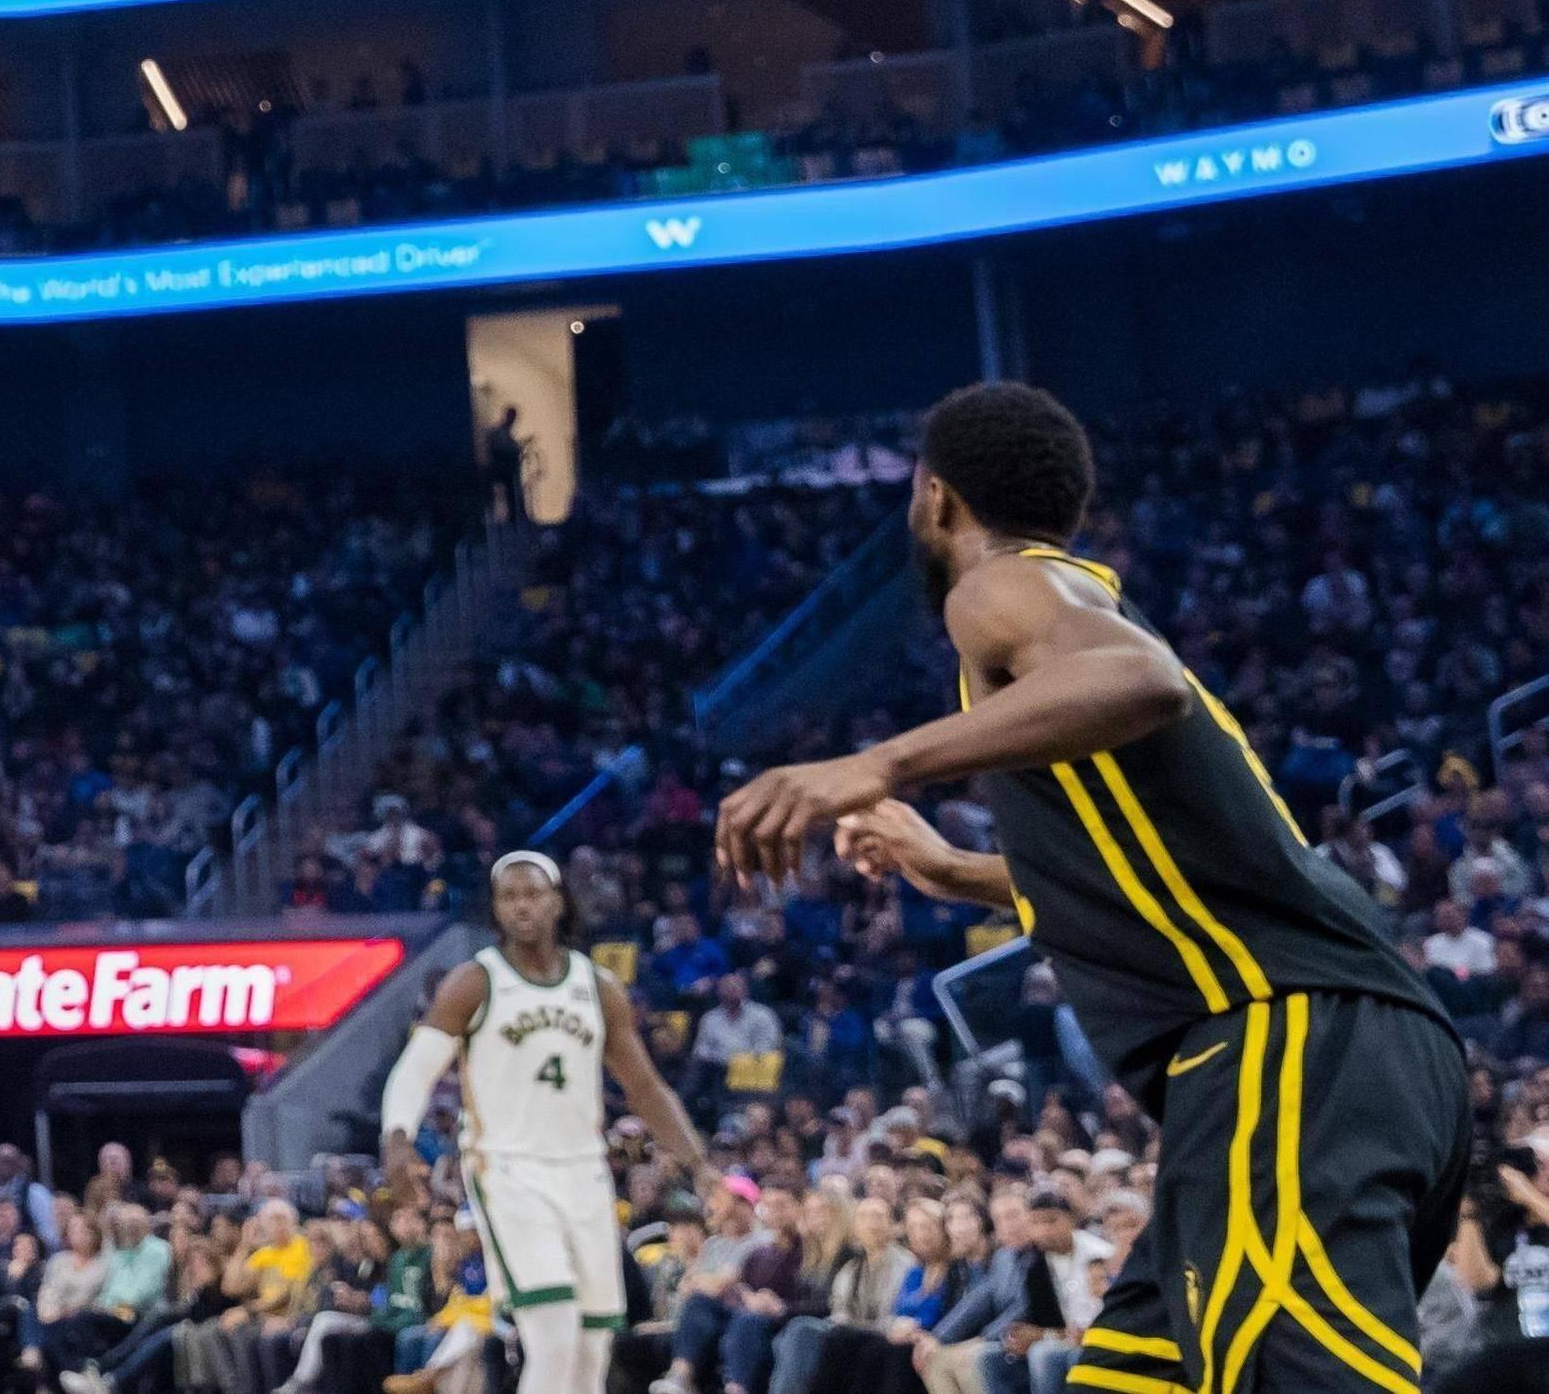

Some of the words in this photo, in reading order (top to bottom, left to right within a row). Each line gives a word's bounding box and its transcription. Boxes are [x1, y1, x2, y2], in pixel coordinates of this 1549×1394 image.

[1153, 137, 1318, 188] WAYMO
[37, 270, 138, 302] World's
[144, 266, 212, 292] Most
[217, 249, 391, 288] Experienced
[395, 242, 480, 273] Driver
[500, 1005, 594, 1046] BOSTON
[535, 1055, 567, 1090] 4
